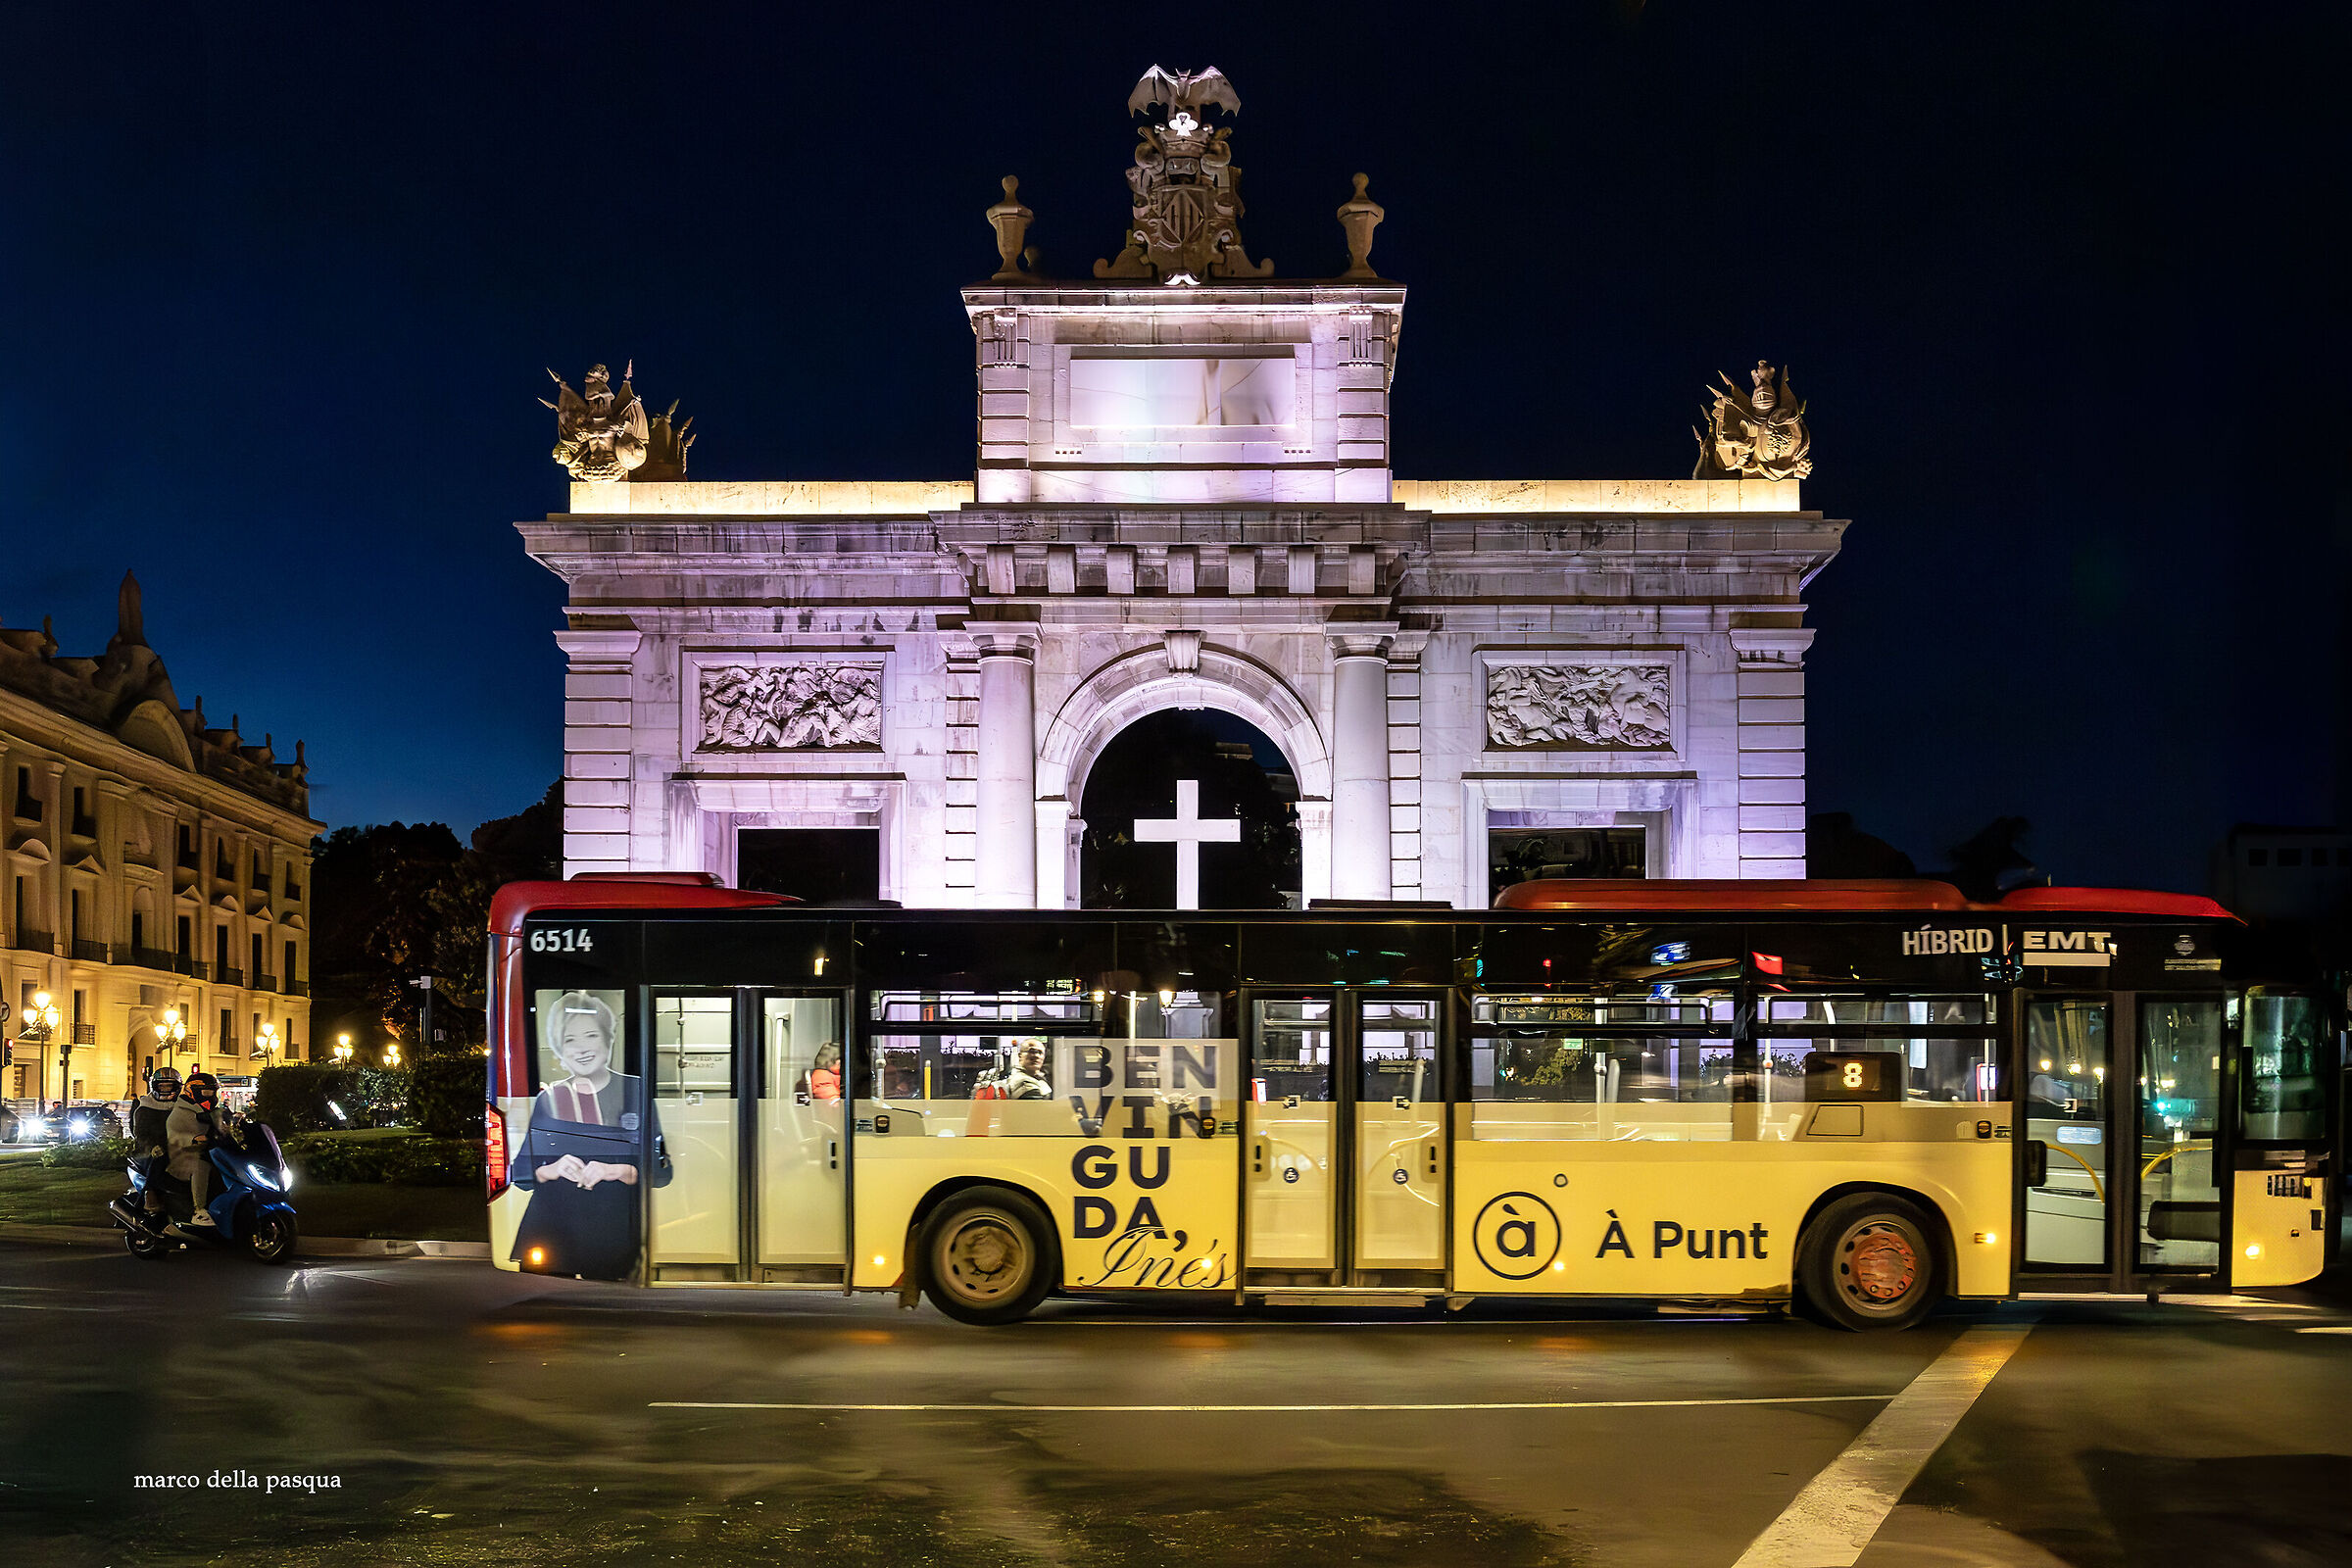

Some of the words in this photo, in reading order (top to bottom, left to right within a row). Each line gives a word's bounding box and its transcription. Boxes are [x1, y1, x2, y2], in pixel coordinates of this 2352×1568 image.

[530, 928, 594, 953] 6514
[1901, 923, 1994, 956] HÍBRID
[2023, 931, 2112, 953] EMT
[1074, 1046, 1216, 1089] BEN
[1842, 1061, 1863, 1088] 8
[1068, 1096, 1213, 1139] VIN
[1071, 1145, 1171, 1190] GU
[1073, 1196, 1189, 1252] DA,
[1594, 1208, 1636, 1259] À
[1653, 1220, 1770, 1260] Punt
[1076, 1224, 1240, 1289] Inés
